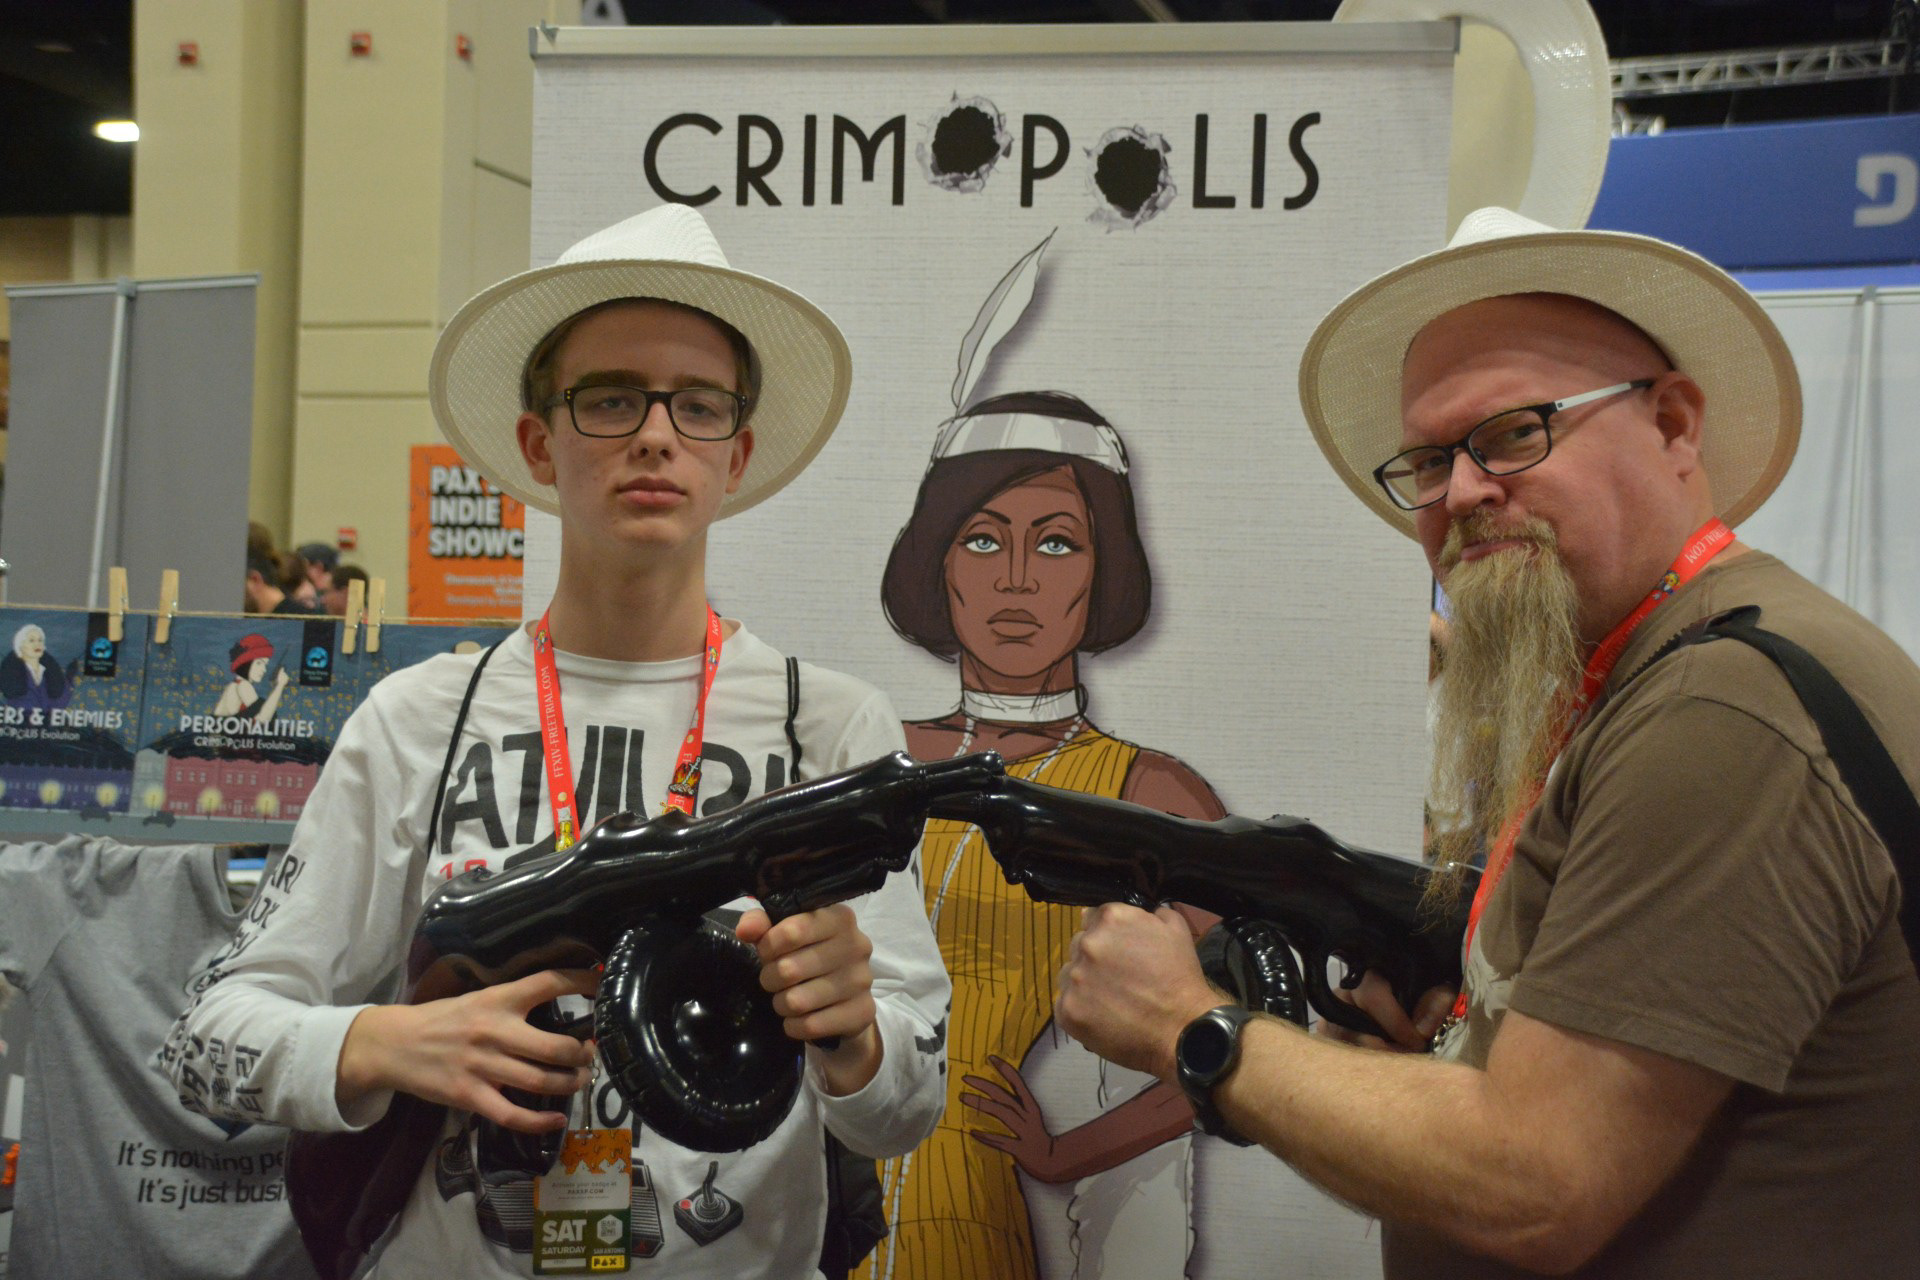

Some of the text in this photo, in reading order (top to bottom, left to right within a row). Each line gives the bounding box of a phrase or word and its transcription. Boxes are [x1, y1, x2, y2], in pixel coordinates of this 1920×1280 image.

[431, 467, 482, 494] PAX
[431, 497, 500, 526] INDIE
[429, 529, 524, 557] SHOWC
[29, 707, 45, 726] &
[51, 708, 123, 729] ENEMIES
[180, 715, 314, 737] PERSONALITIES
[541, 665, 562, 778] FFXIV-FREETRIAL.COM
[40, 729, 80, 740] Evolution
[256, 739, 296, 750] Evolution
[118, 1141, 157, 1167] It's
[161, 1149, 254, 1175] nothing
[137, 1178, 177, 1203] It's
[178, 1179, 229, 1210] just
[542, 1219, 587, 1243] SAT
[542, 1246, 586, 1255] SATURDAY
[593, 1257, 617, 1267] PAX
